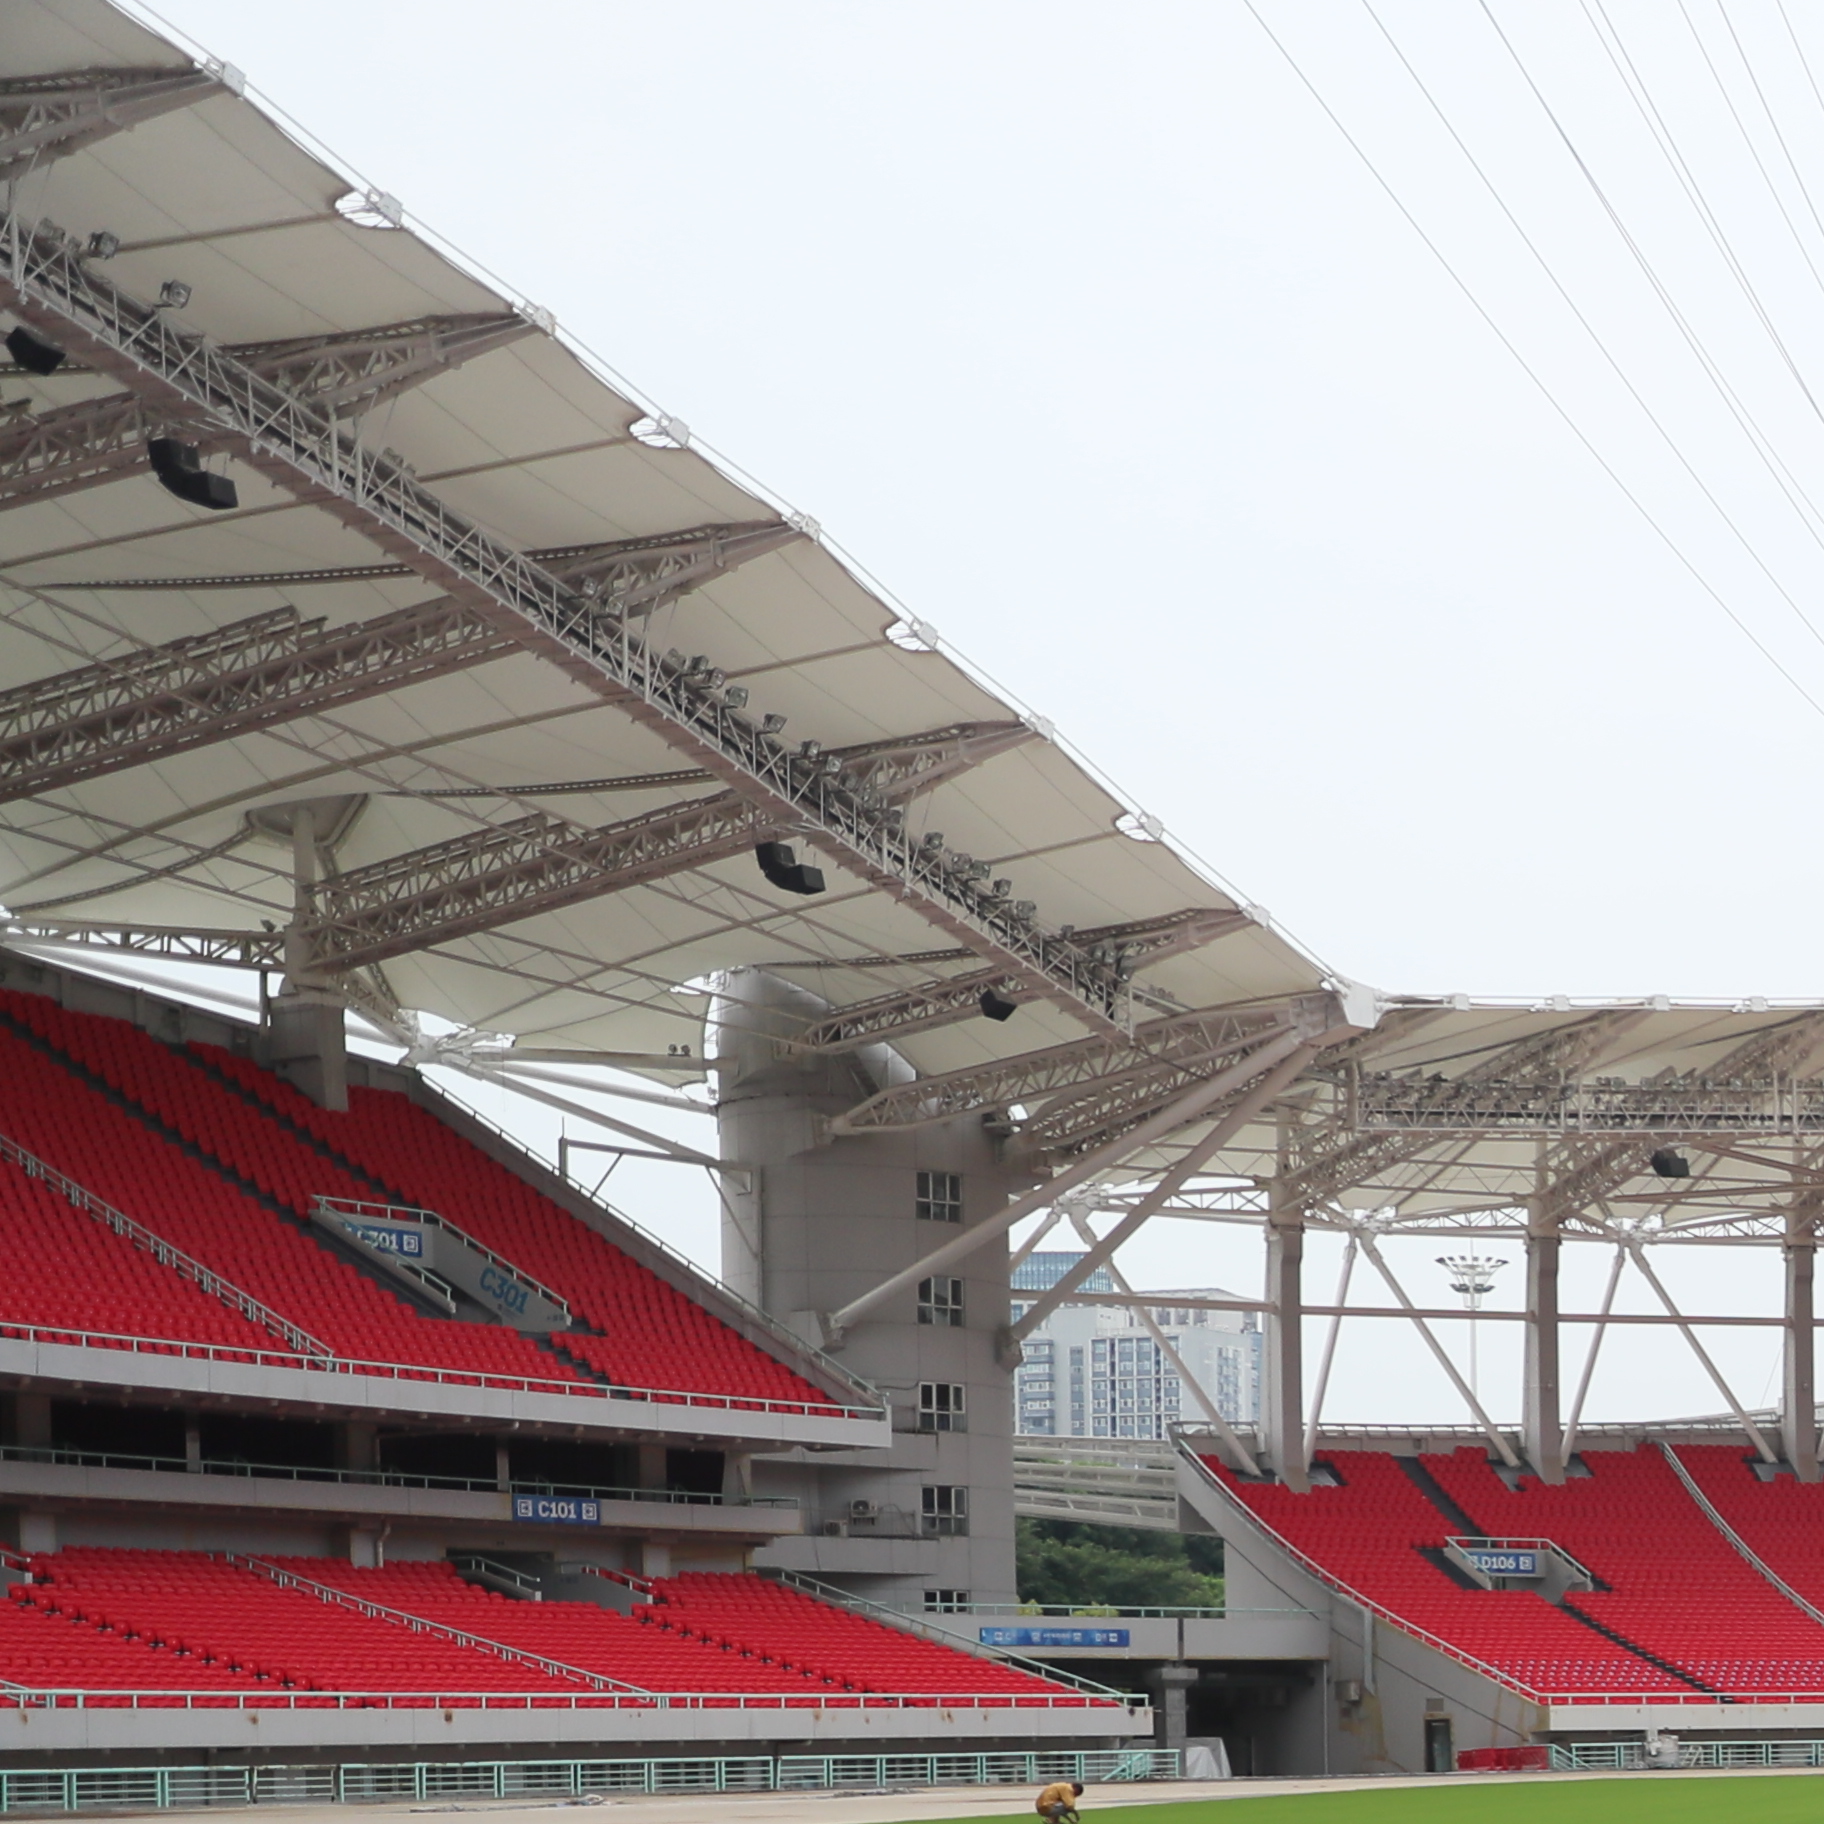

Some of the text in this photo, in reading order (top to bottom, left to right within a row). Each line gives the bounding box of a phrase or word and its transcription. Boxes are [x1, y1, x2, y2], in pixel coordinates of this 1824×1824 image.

[479, 1267, 529, 1315] C301
[538, 1501, 577, 1518] C101
[1481, 1556, 1516, 1570] D106
